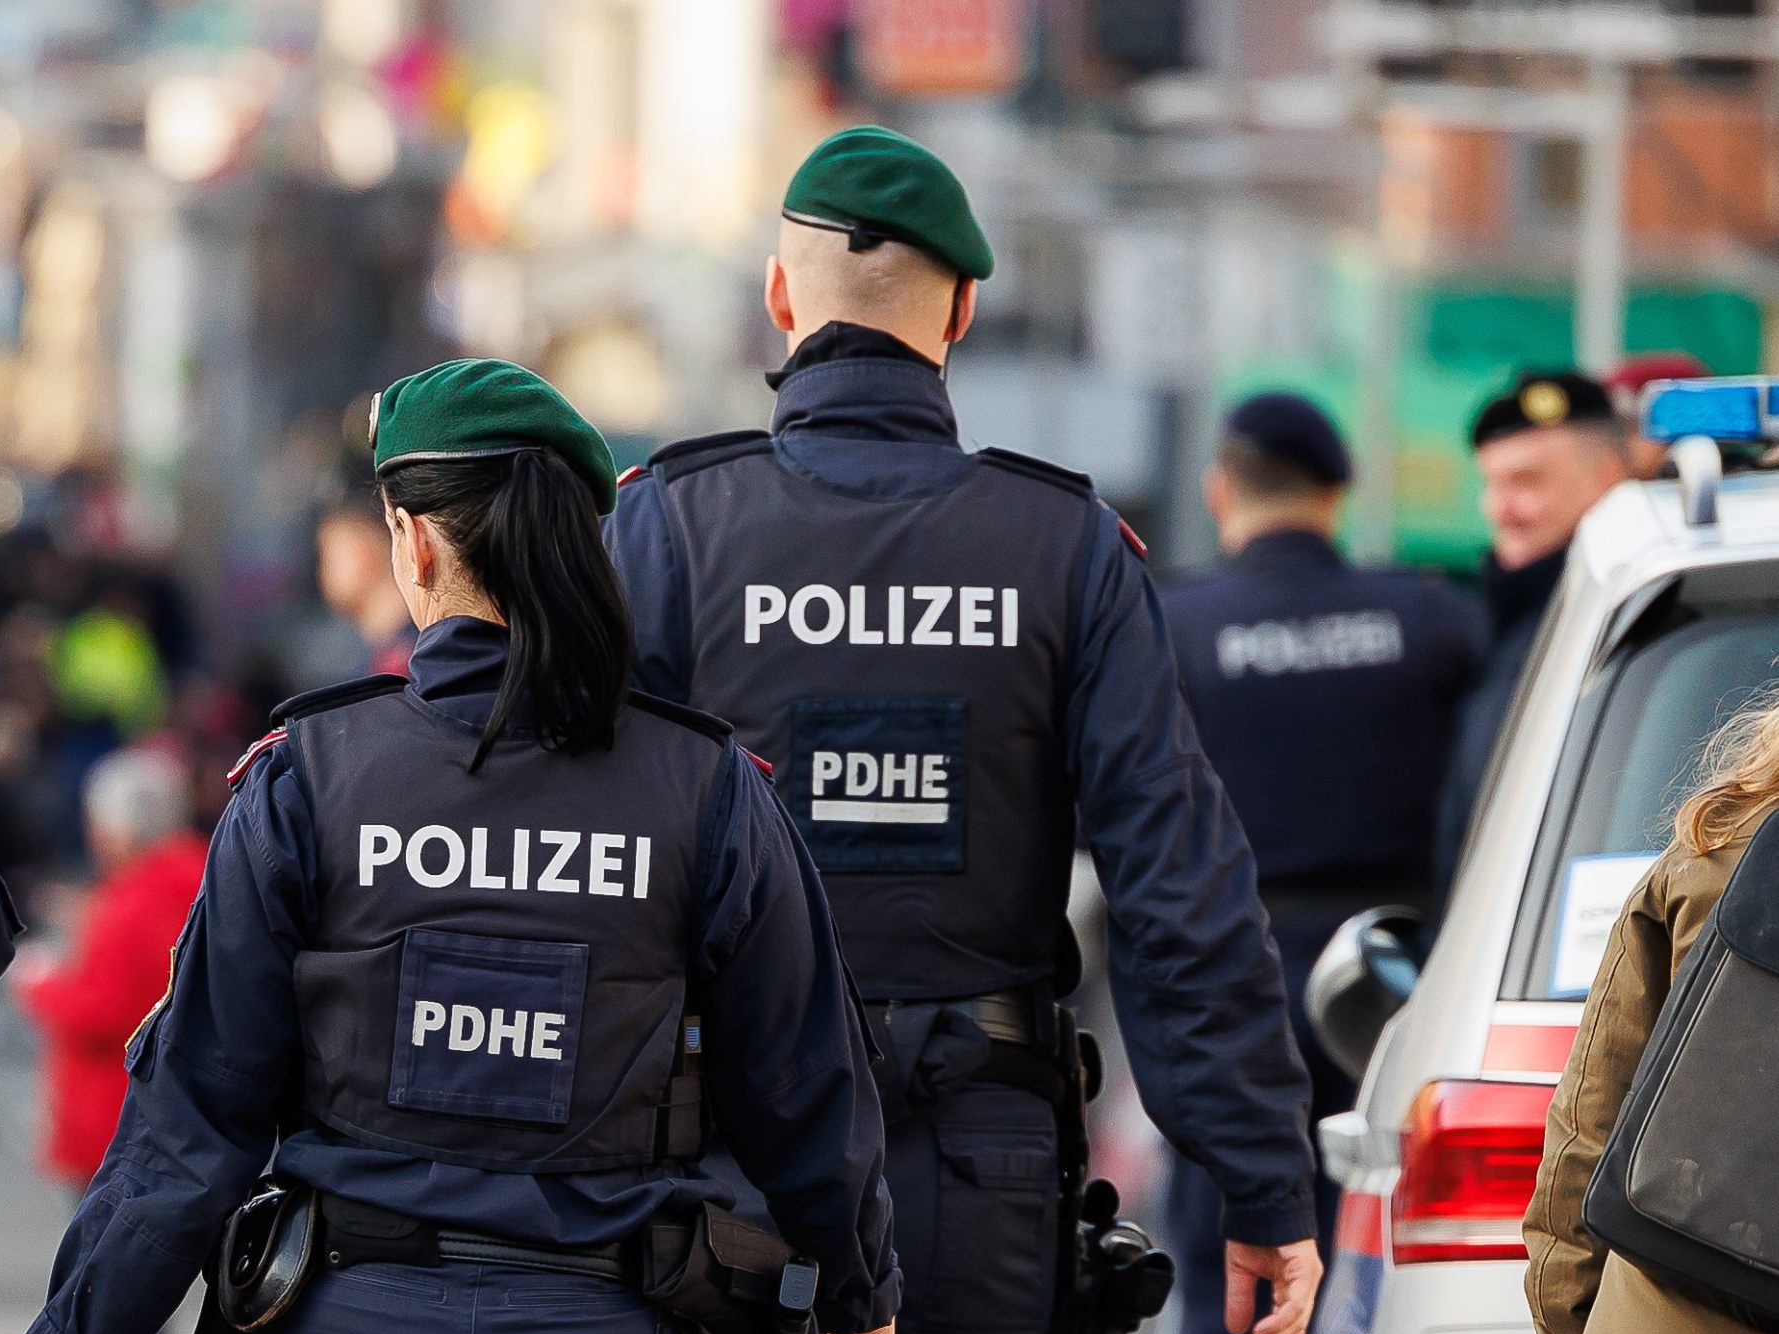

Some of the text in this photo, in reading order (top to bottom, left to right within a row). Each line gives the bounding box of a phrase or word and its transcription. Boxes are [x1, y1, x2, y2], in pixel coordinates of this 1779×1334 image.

[743, 582, 1020, 648] POLIZEI
[810, 750, 951, 800] PDHE
[357, 823, 652, 900] POLIZEI
[410, 999, 567, 1062] PDHE
